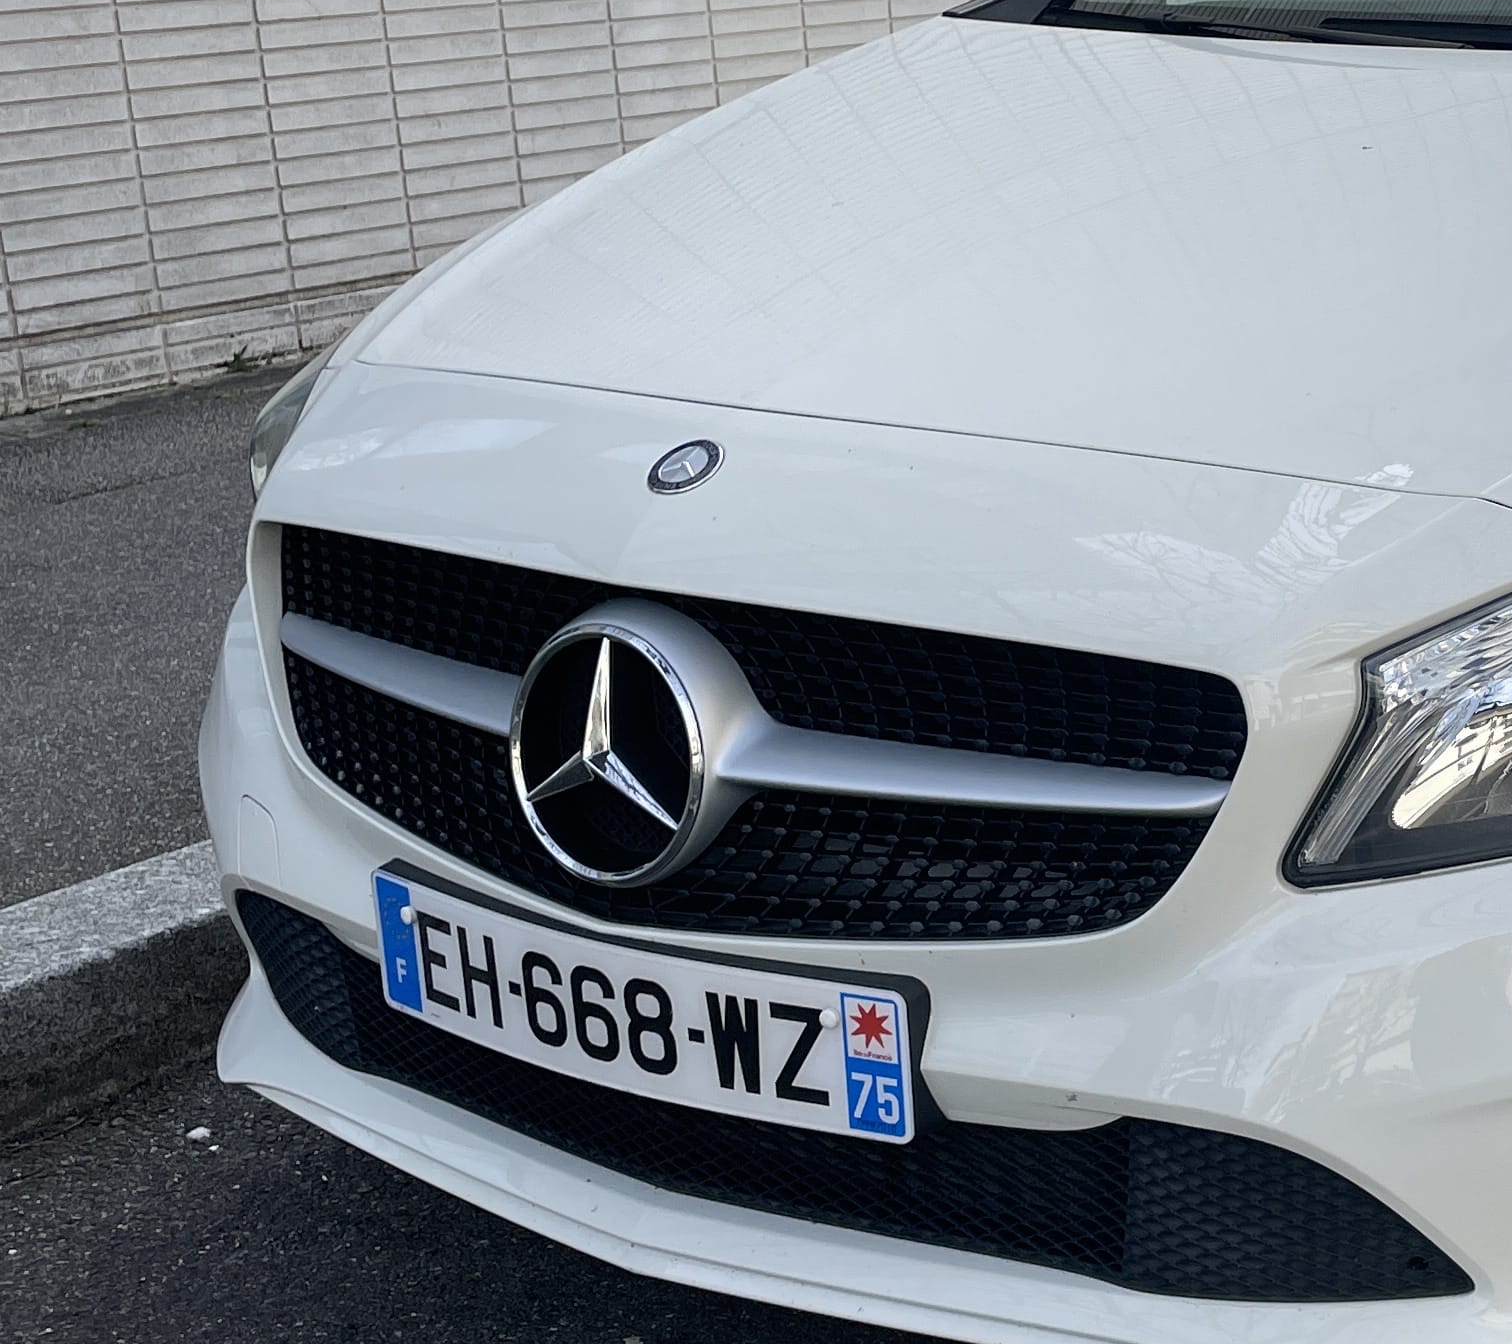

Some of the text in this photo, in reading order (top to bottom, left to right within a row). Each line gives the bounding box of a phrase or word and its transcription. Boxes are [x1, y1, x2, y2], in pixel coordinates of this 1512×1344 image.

[395, 956, 408, 984] F
[417, 910, 831, 1108] EH-668-WZ
[851, 1071, 900, 1125] 75
